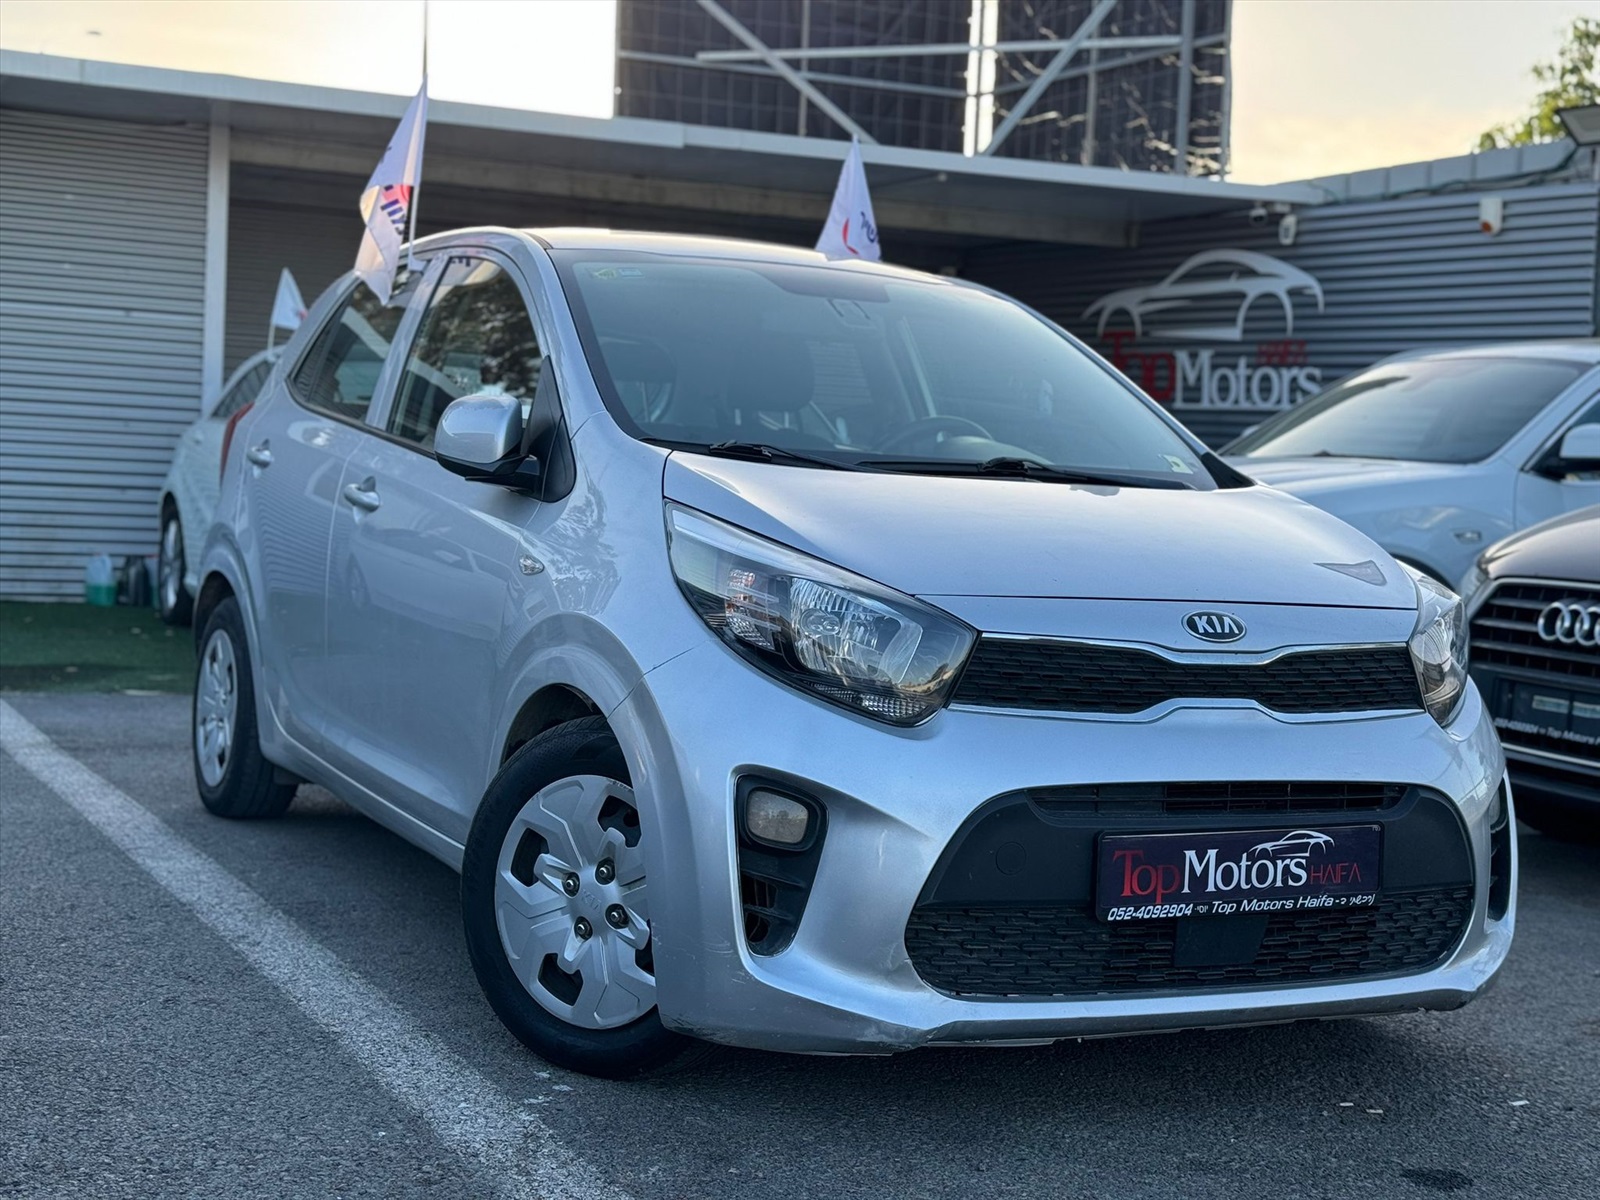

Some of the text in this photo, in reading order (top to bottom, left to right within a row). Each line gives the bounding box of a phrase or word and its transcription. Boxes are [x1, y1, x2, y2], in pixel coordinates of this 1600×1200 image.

[1173, 350, 1322, 410] Motors
[1191, 615, 1240, 634] KIA
[1112, 848, 1362, 905] Top Motors HAIFA
[1107, 903, 1194, 921] 052-4092904
[1212, 901, 1237, 915] Top
[1240, 899, 1294, 912] Motors
[1296, 895, 1334, 909] Haifa
